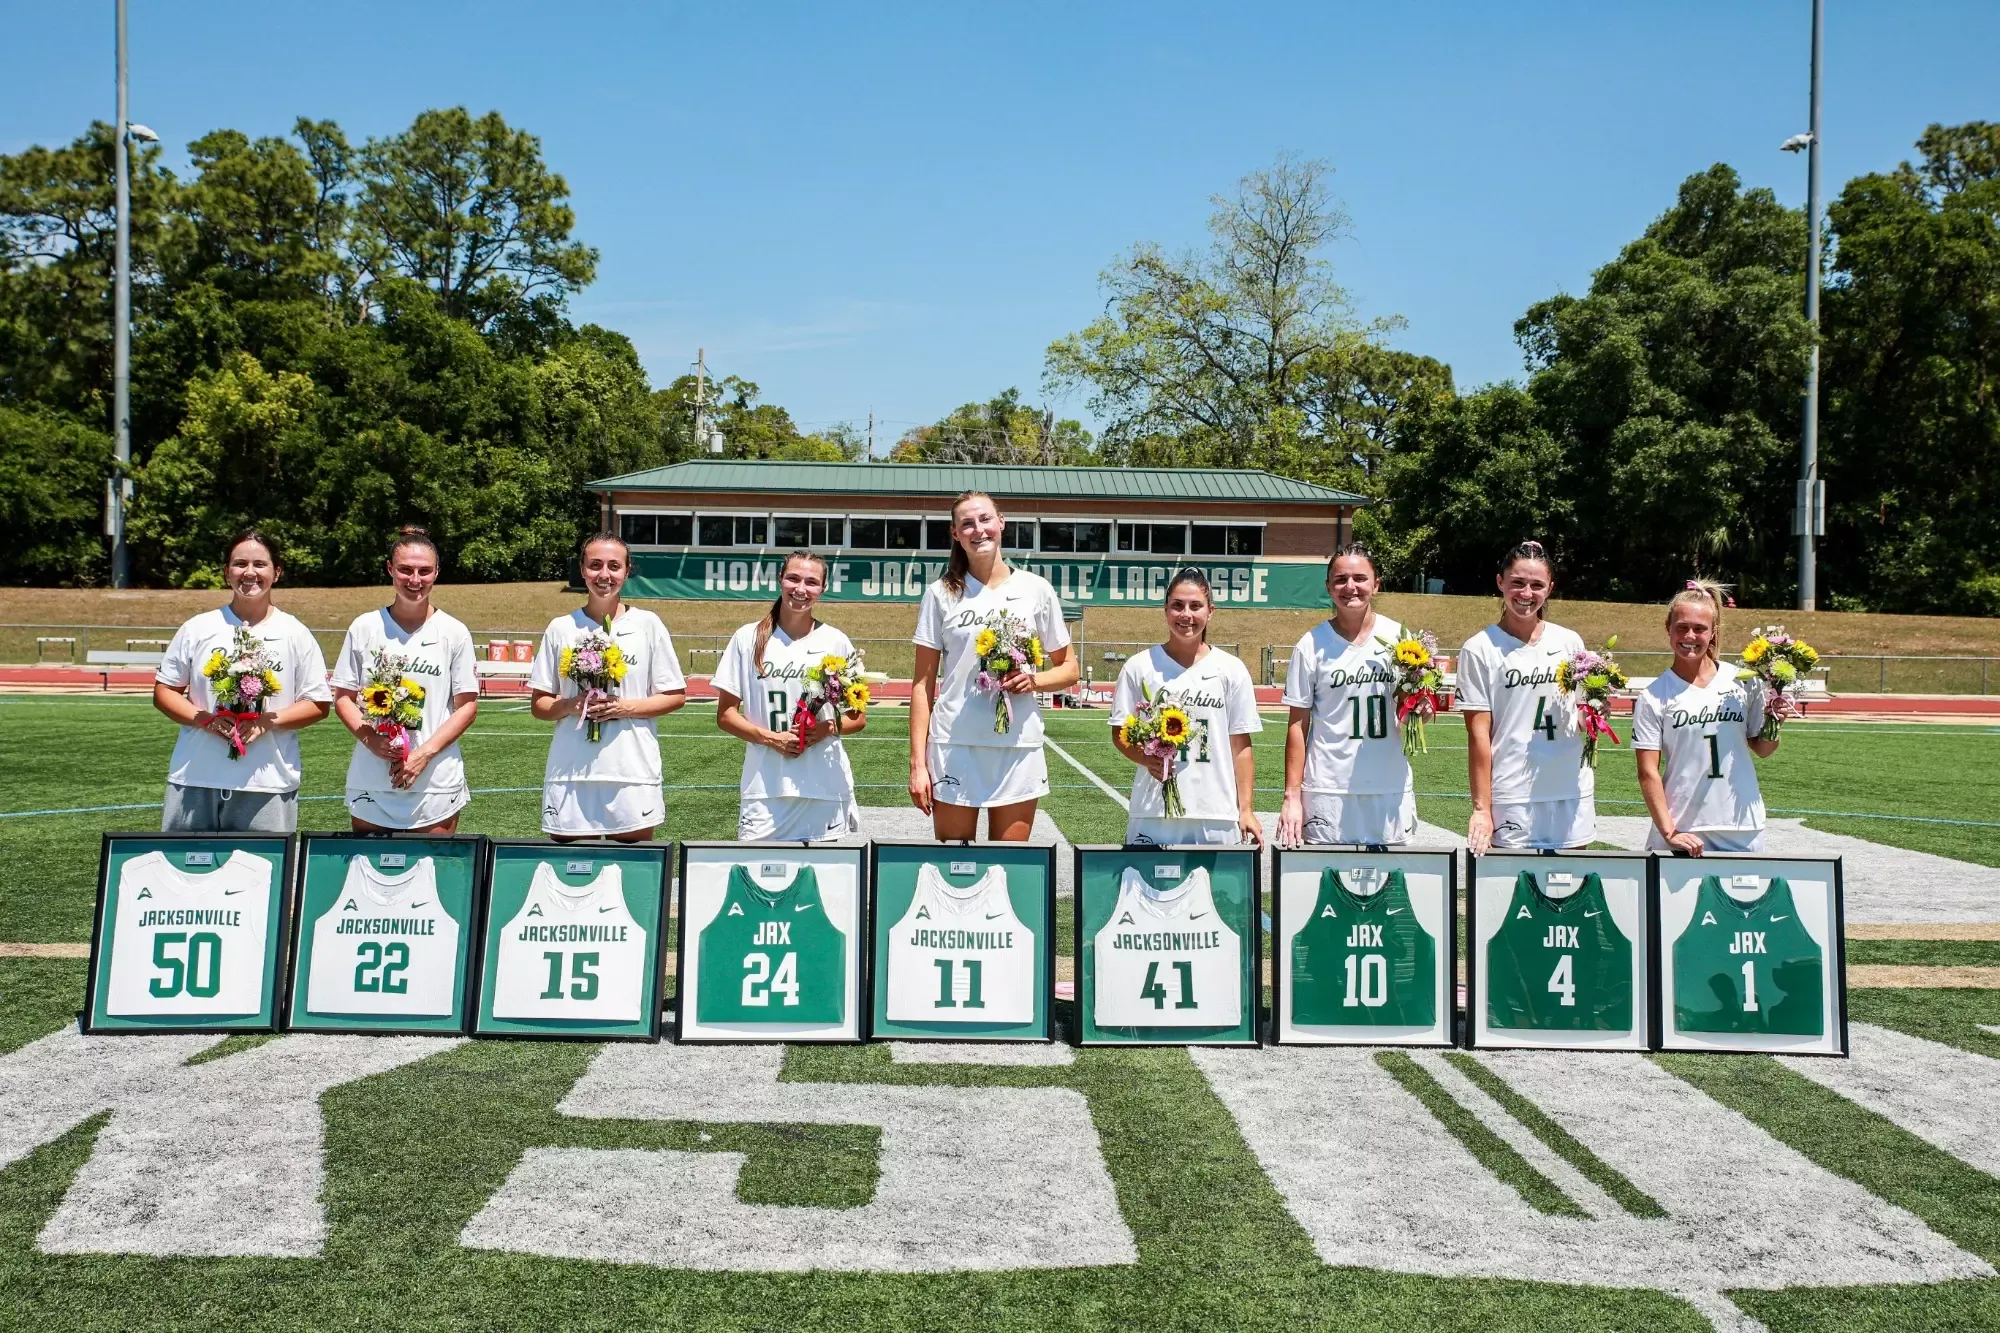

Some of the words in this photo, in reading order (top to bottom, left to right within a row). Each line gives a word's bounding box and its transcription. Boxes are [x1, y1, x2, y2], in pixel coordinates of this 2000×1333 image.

[705, 560, 779, 592] HOM
[1109, 566, 1269, 602] LACSSE
[757, 661, 806, 683] Dolph
[1347, 694, 1388, 740] 10
[1533, 696, 1557, 741] 4
[1672, 705, 1745, 729] Dolphins
[1703, 734, 1724, 779] 1
[138, 909, 241, 928] JACKSONVILLE
[336, 918, 436, 936] JACKSONVILLE
[518, 924, 628, 943] JACKSONVILLE
[752, 921, 792, 946] JAX
[910, 928, 1014, 950] JACKSONVILLE
[1346, 924, 1384, 948] JAX
[1542, 925, 1580, 949] JAX
[1113, 930, 1221, 951] JACKSONVILLE
[1729, 931, 1768, 955] JAX
[148, 931, 223, 999] 50
[353, 941, 410, 995] 22
[539, 951, 600, 1001] 15
[741, 951, 800, 1006] 24
[933, 958, 986, 1009] 11
[1139, 960, 1199, 1010] 41
[1342, 953, 1388, 1007] 10
[1547, 954, 1576, 1006] 4
[1741, 960, 1759, 1012] 1
